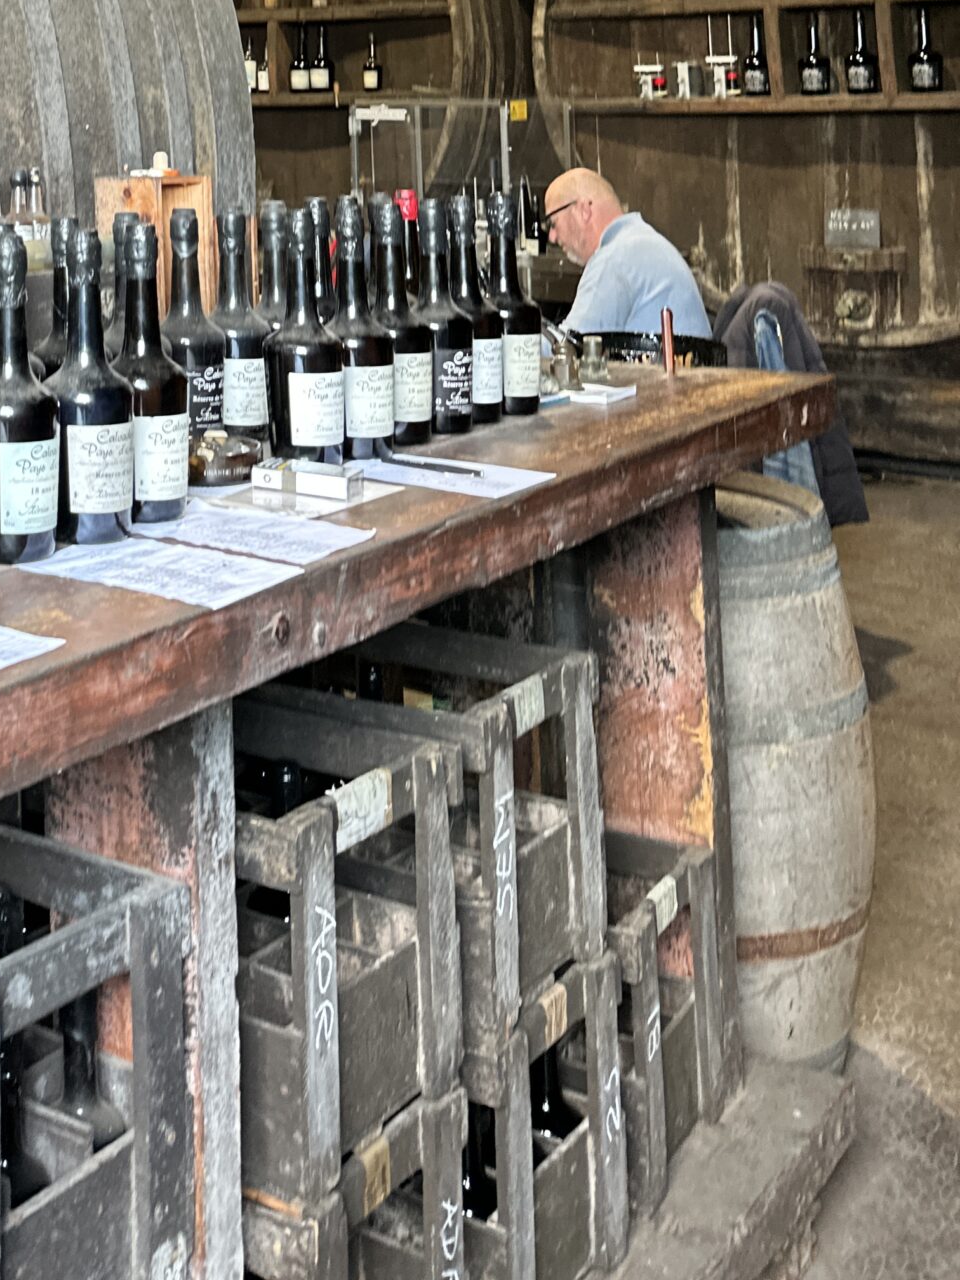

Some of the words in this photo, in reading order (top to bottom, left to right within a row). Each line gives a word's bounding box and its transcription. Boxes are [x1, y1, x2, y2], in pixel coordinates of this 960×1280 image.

[442, 361, 466, 376] Pays
[192, 377, 216, 392] Pays
[96, 428, 133, 445] Calvad
[147, 431, 176, 447] Pays
[30, 444, 57, 461] Calva
[81, 442, 113, 459] Pays
[15, 458, 46, 476] Pays
